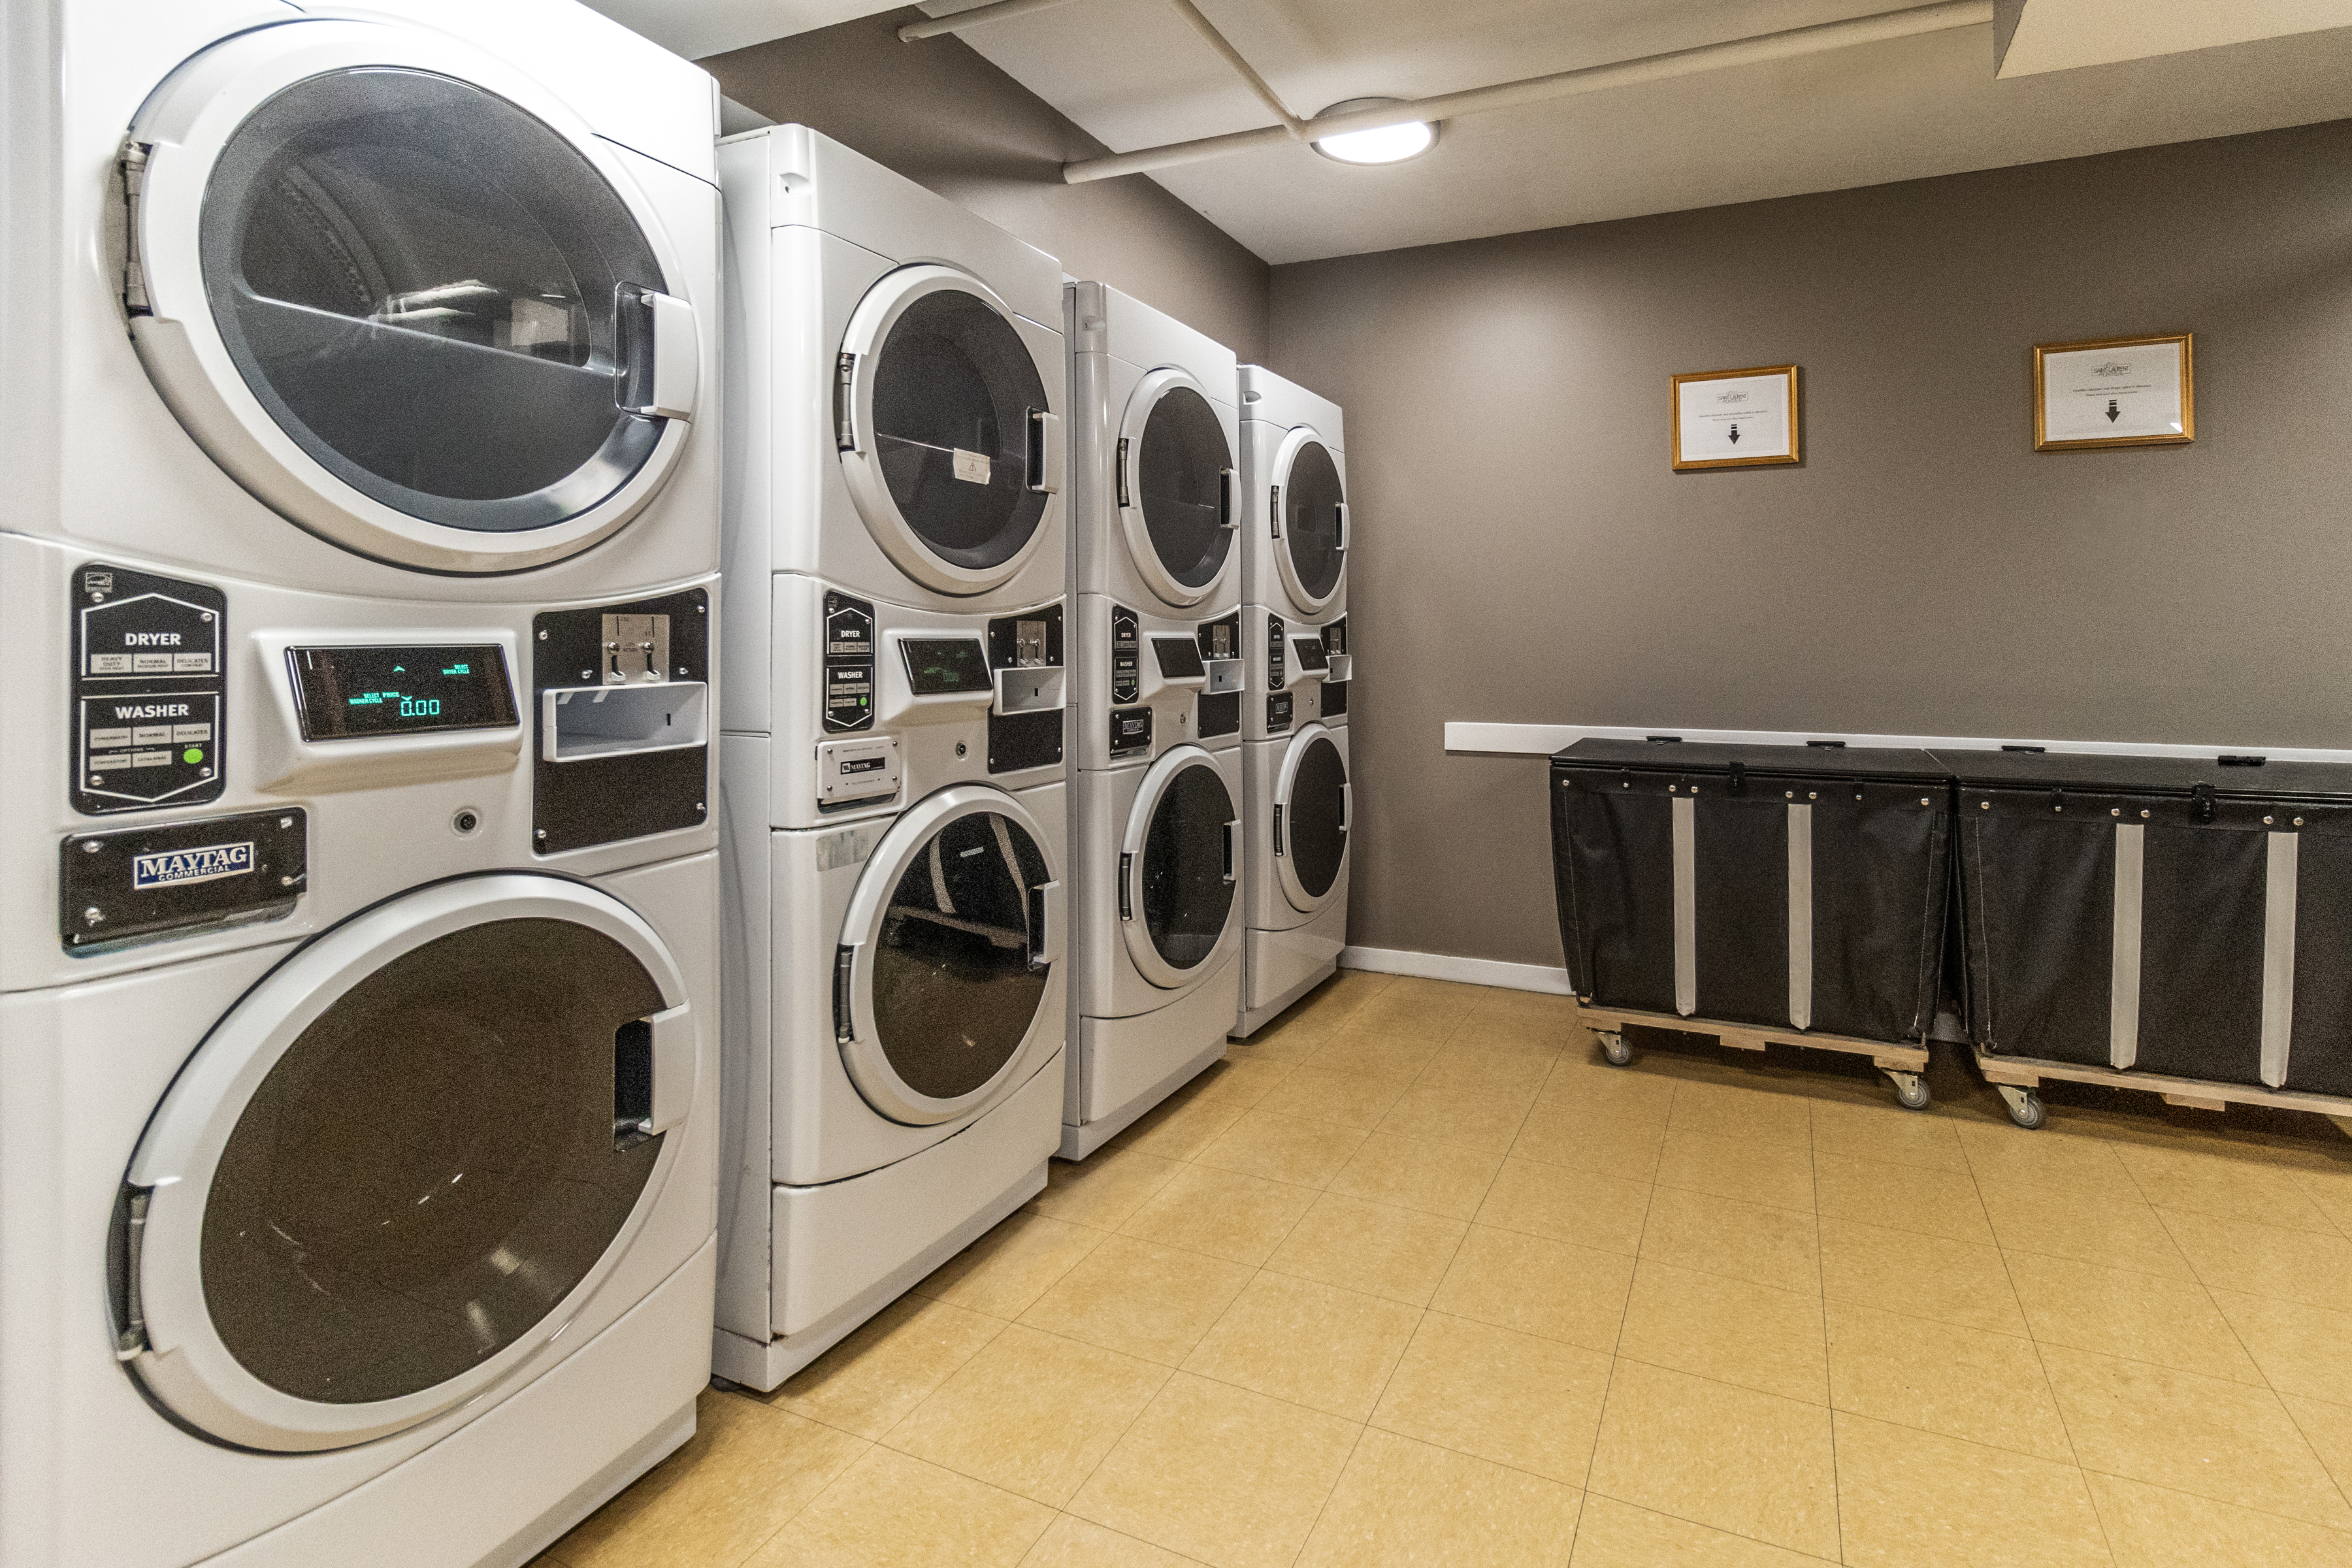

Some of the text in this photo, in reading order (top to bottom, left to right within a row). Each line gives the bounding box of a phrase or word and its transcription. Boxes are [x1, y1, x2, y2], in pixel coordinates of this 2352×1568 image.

[125, 632, 182, 646] DRYER
[115, 704, 189, 720] WASHER
[400, 699, 440, 717] 0.00
[140, 846, 247, 878] MAYTAG
[157, 864, 231, 882] COMMERCIAL
